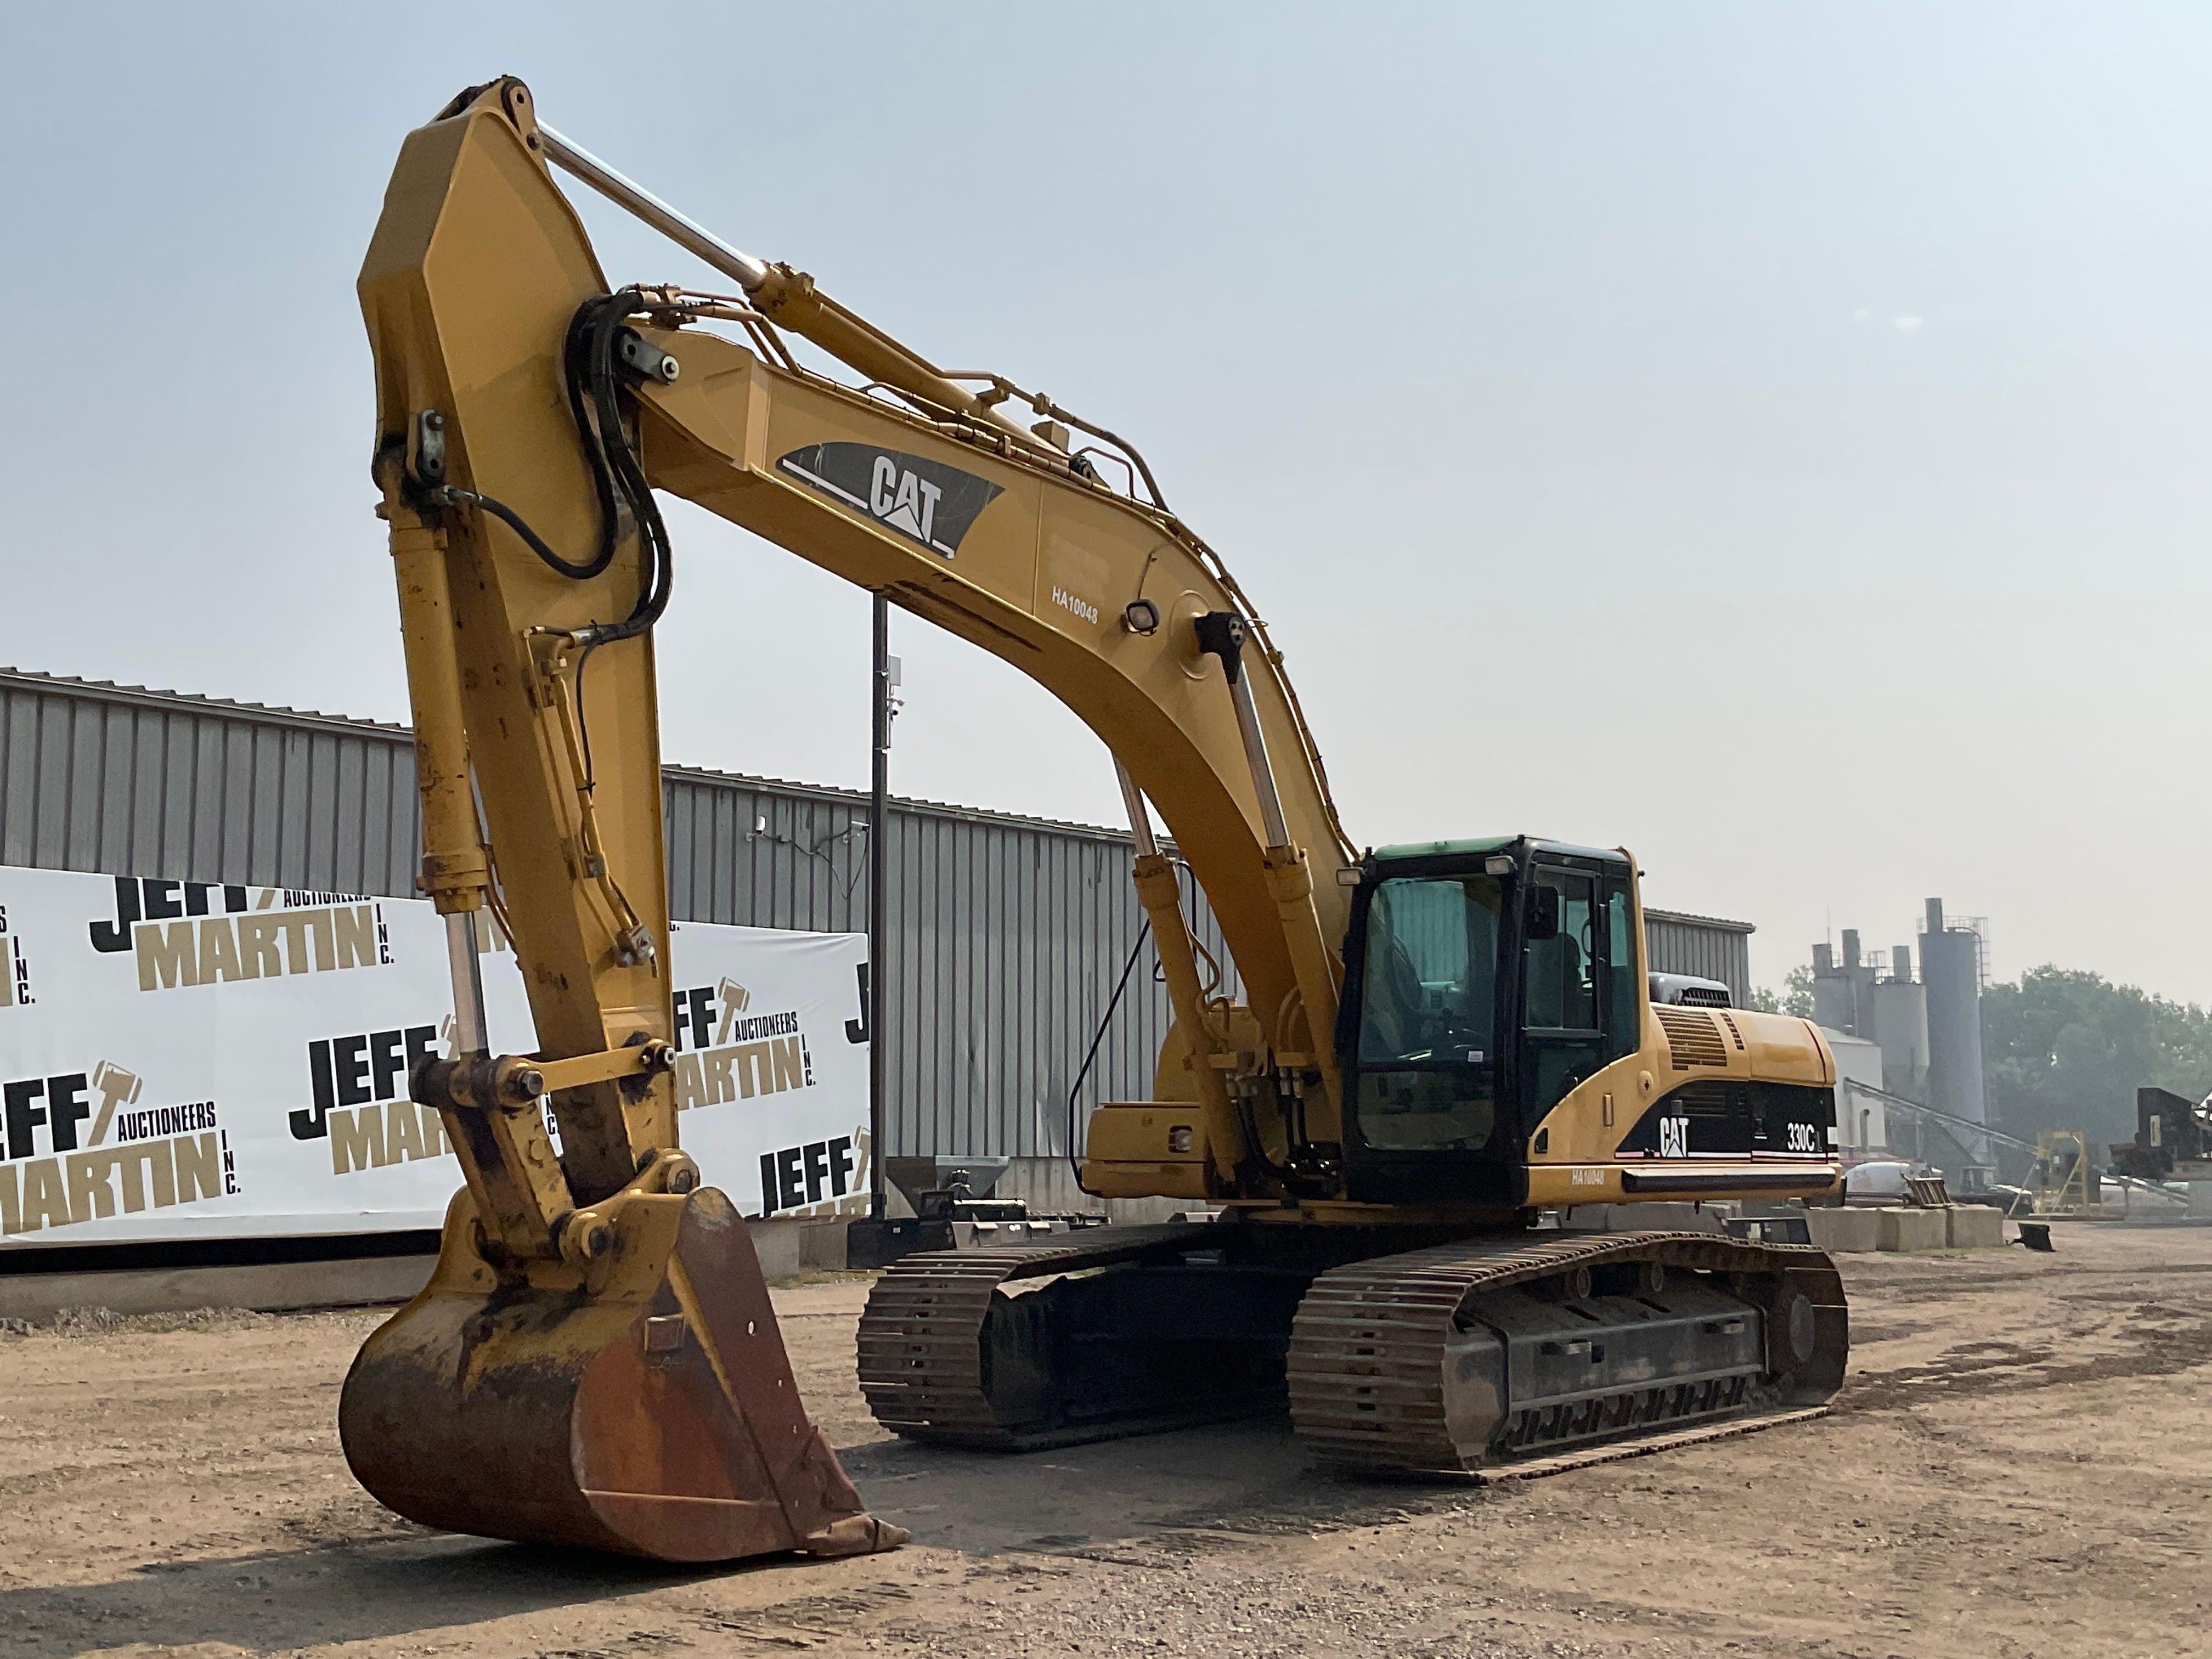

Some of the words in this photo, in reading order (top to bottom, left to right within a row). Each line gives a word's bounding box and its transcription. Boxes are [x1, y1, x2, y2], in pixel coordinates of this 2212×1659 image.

[870, 455, 941, 543] CAT
[1052, 585, 1098, 624] HA10048
[134, 905, 376, 991] MARTIN
[735, 1011, 798, 1042] AUCTIONEERS
[677, 1036, 803, 1110] ARTIN
[118, 1101, 216, 1142] AUCTIONEERS
[1660, 1117, 1690, 1158] CAT
[1787, 1122, 1815, 1152] 330C
